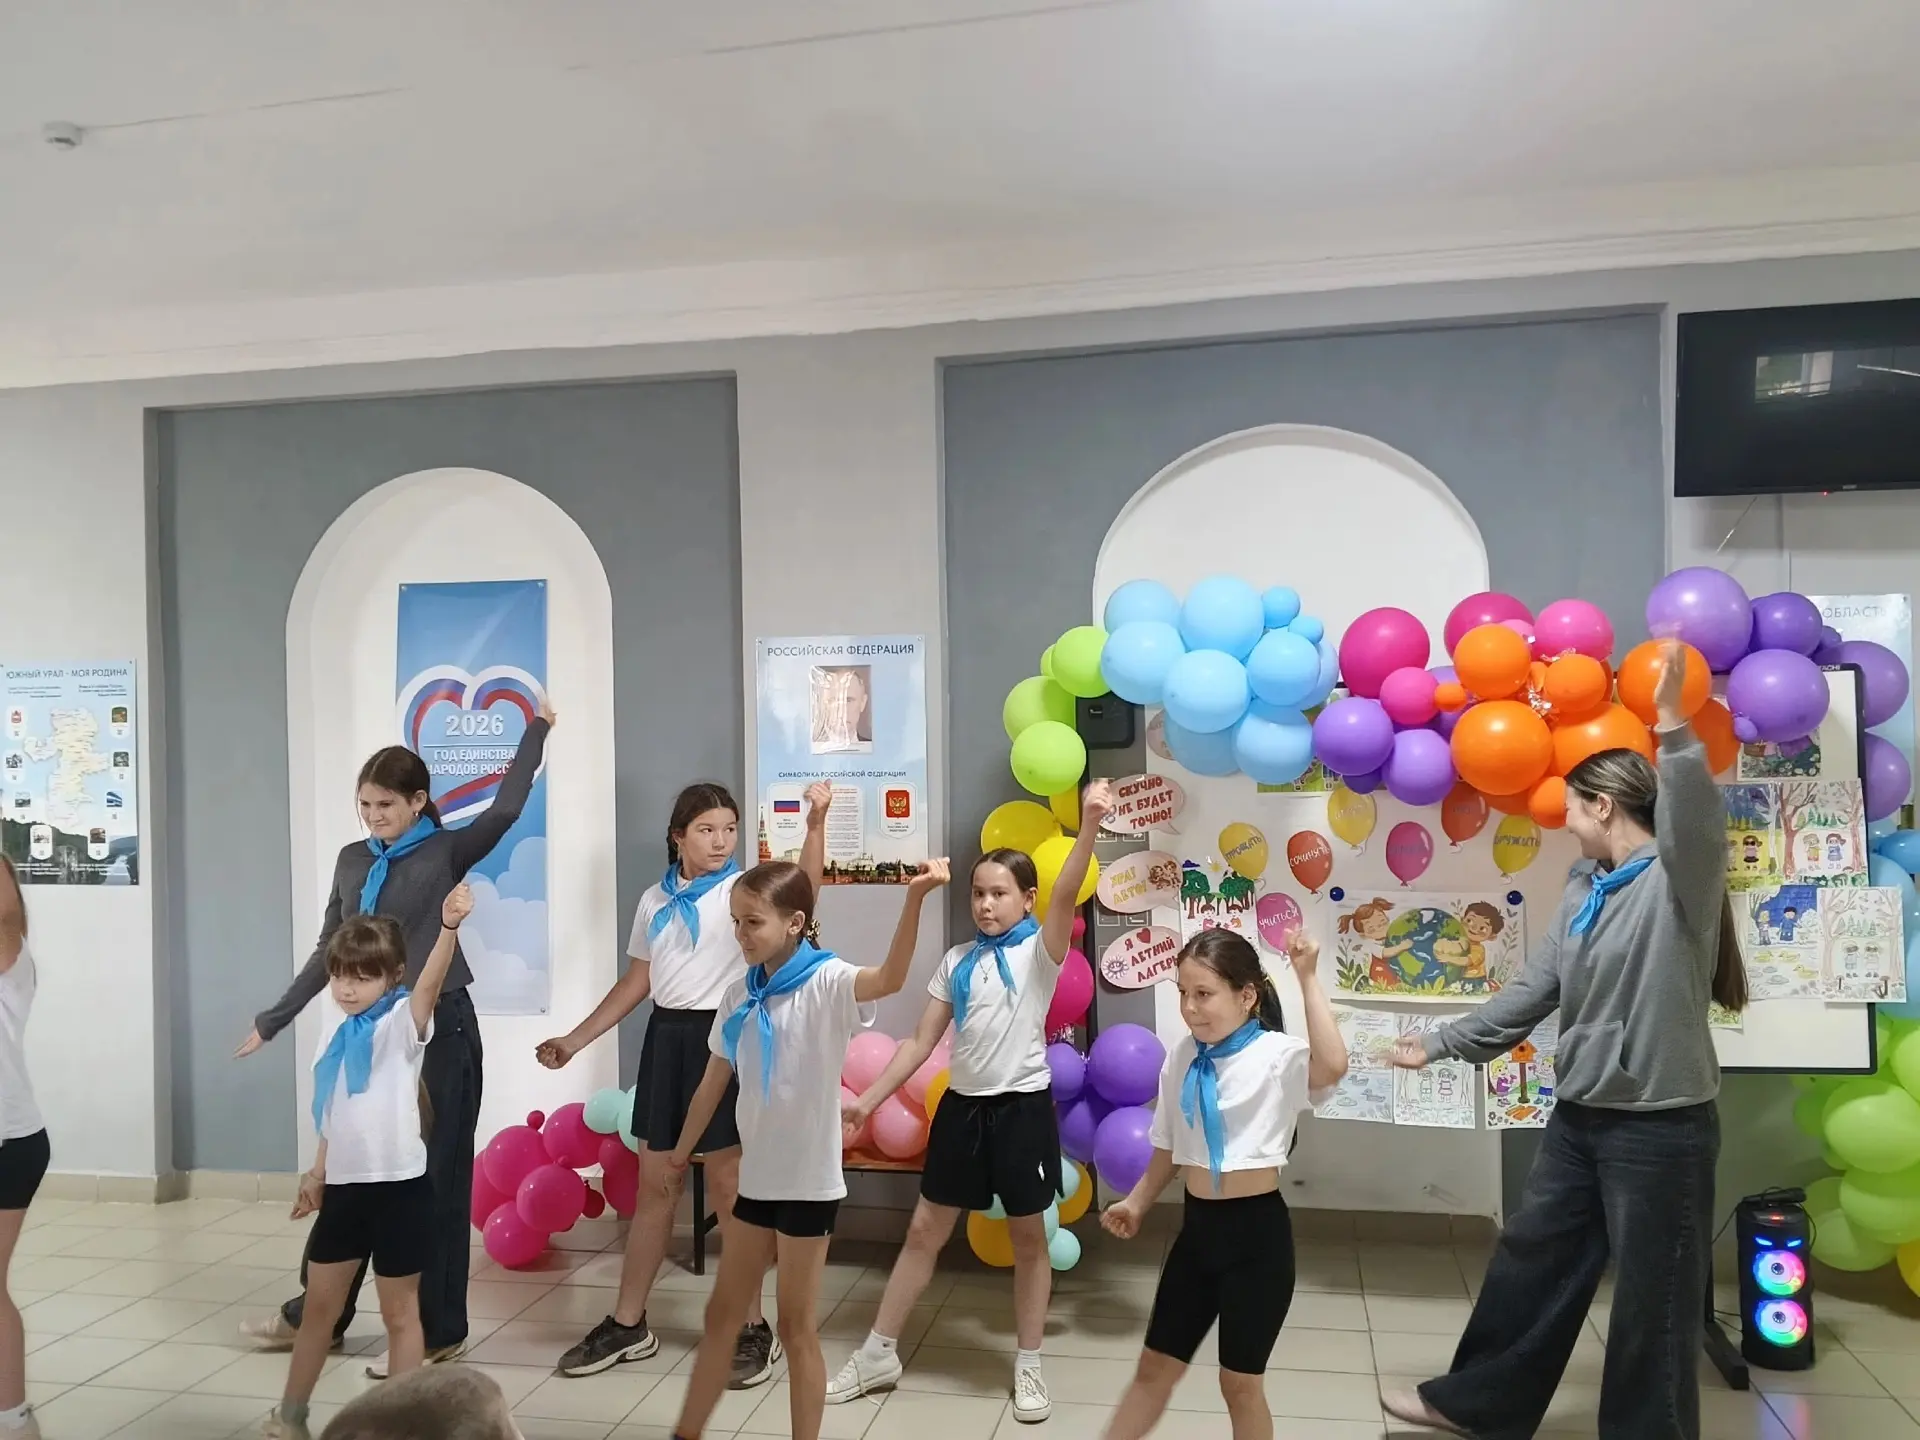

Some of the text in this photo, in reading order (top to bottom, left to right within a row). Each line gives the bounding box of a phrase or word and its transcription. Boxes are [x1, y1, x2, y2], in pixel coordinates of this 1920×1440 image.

[1822, 606, 1887, 618] ОБЛАСТЬ
[767, 644, 914, 657] РОССИЙСКАЯ ФЕДЕРАЦИЯ
[6, 669, 41, 679] ЮЖНЫЙ
[43, 670, 64, 678] УРАЛ
[71, 669, 90, 677] МОЯ
[92, 668, 128, 678] РОДИНА
[445, 714, 504, 737] 2026
[434, 749, 516, 762] ГОД ЕДИНСТВА
[480, 763, 513, 775] РОСС
[821, 770, 866, 778] РОССИЙСКОЙ
[1118, 776, 1163, 798] СКУЧНО
[1118, 790, 1173, 816] НЕ БУДЕТ
[1129, 807, 1172, 830] ТОЧНО!
[1258, 906, 1299, 928] УЧИТЬСЯ
[1124, 938, 1134, 951] Я
[1131, 936, 1175, 967] ЛЕТНИЙ
